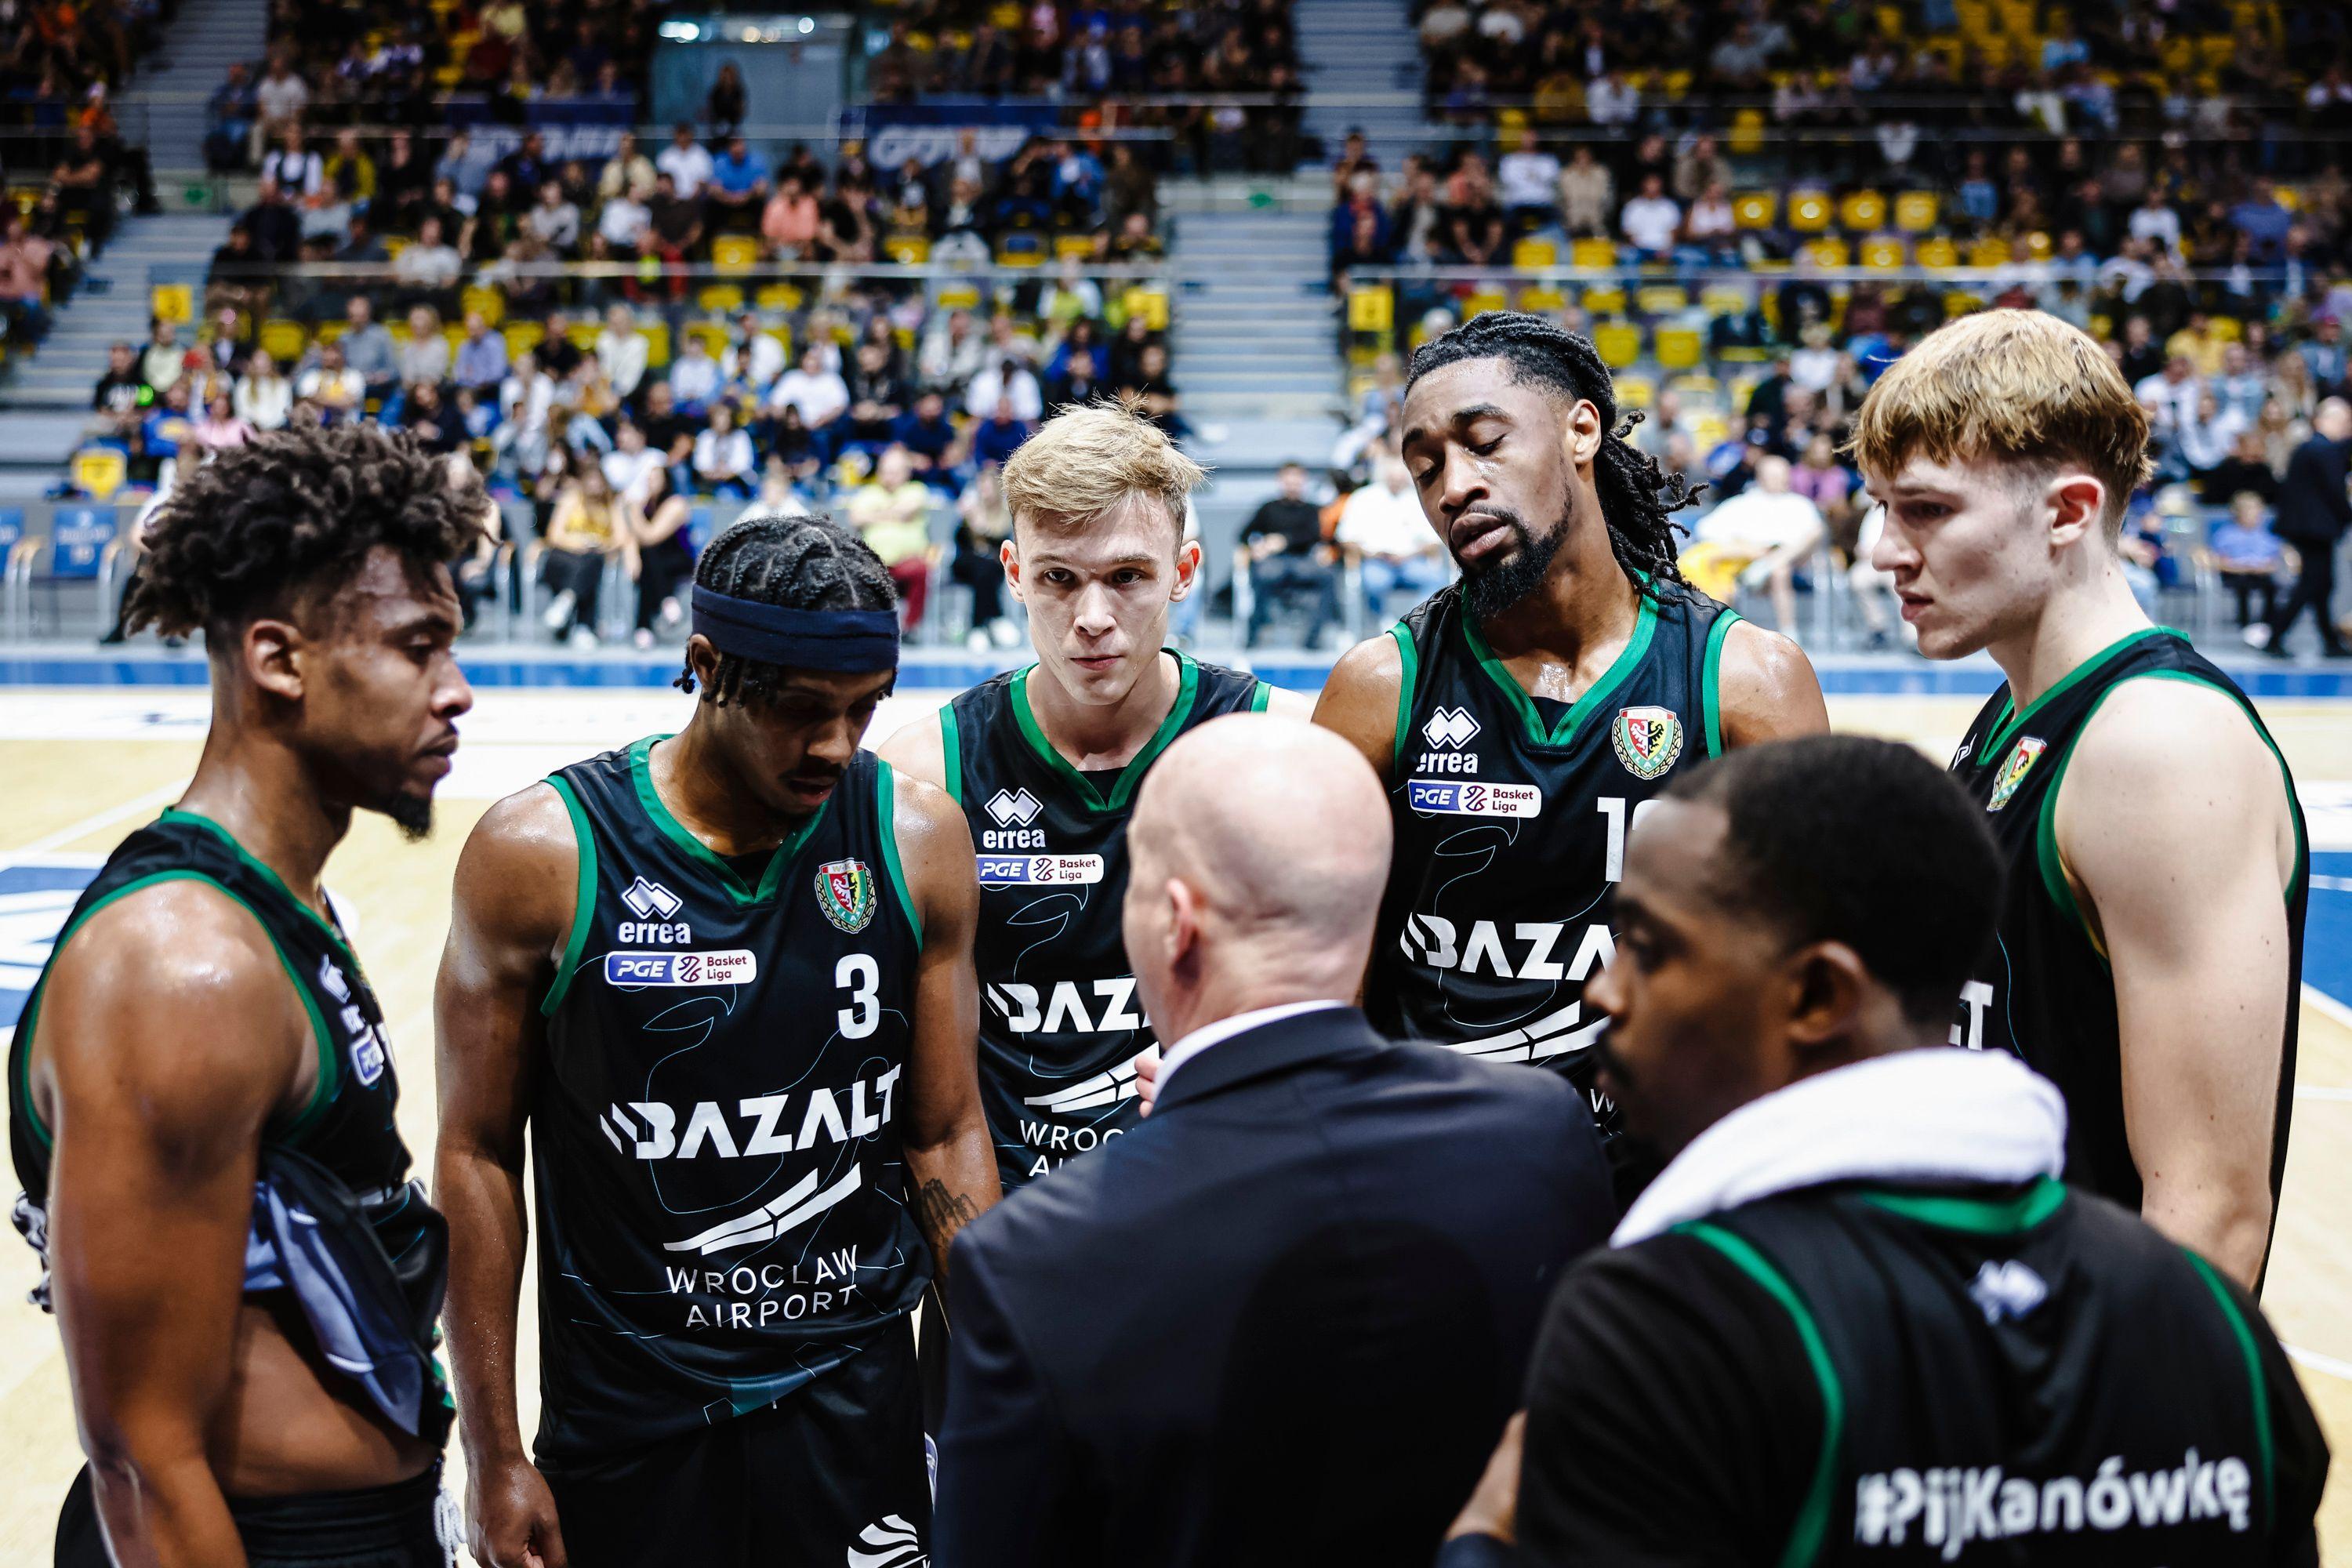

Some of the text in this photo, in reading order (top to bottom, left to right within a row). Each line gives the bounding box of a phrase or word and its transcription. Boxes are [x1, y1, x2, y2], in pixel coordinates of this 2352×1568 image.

[1414, 788, 1454, 805] PGE
[1493, 788, 1534, 800] Basket
[1492, 800, 1517, 813] Liga
[980, 862, 1024, 877] PGE
[1059, 858, 1096, 869] Basket
[1059, 870, 1082, 880] Liga
[617, 960, 666, 978] PGE
[706, 955, 747, 967] Basket
[706, 969, 731, 981] Liga
[835, 953, 880, 1040] 3
[998, 978, 1152, 1033] BAZ
[627, 1063, 902, 1160] BAZALT
[1019, 1119, 1135, 1152] WROC
[666, 1244, 857, 1294] WROCLAW
[685, 1283, 857, 1330] AIRPORT
[1855, 1447, 2251, 1561] #PijKanówkę
